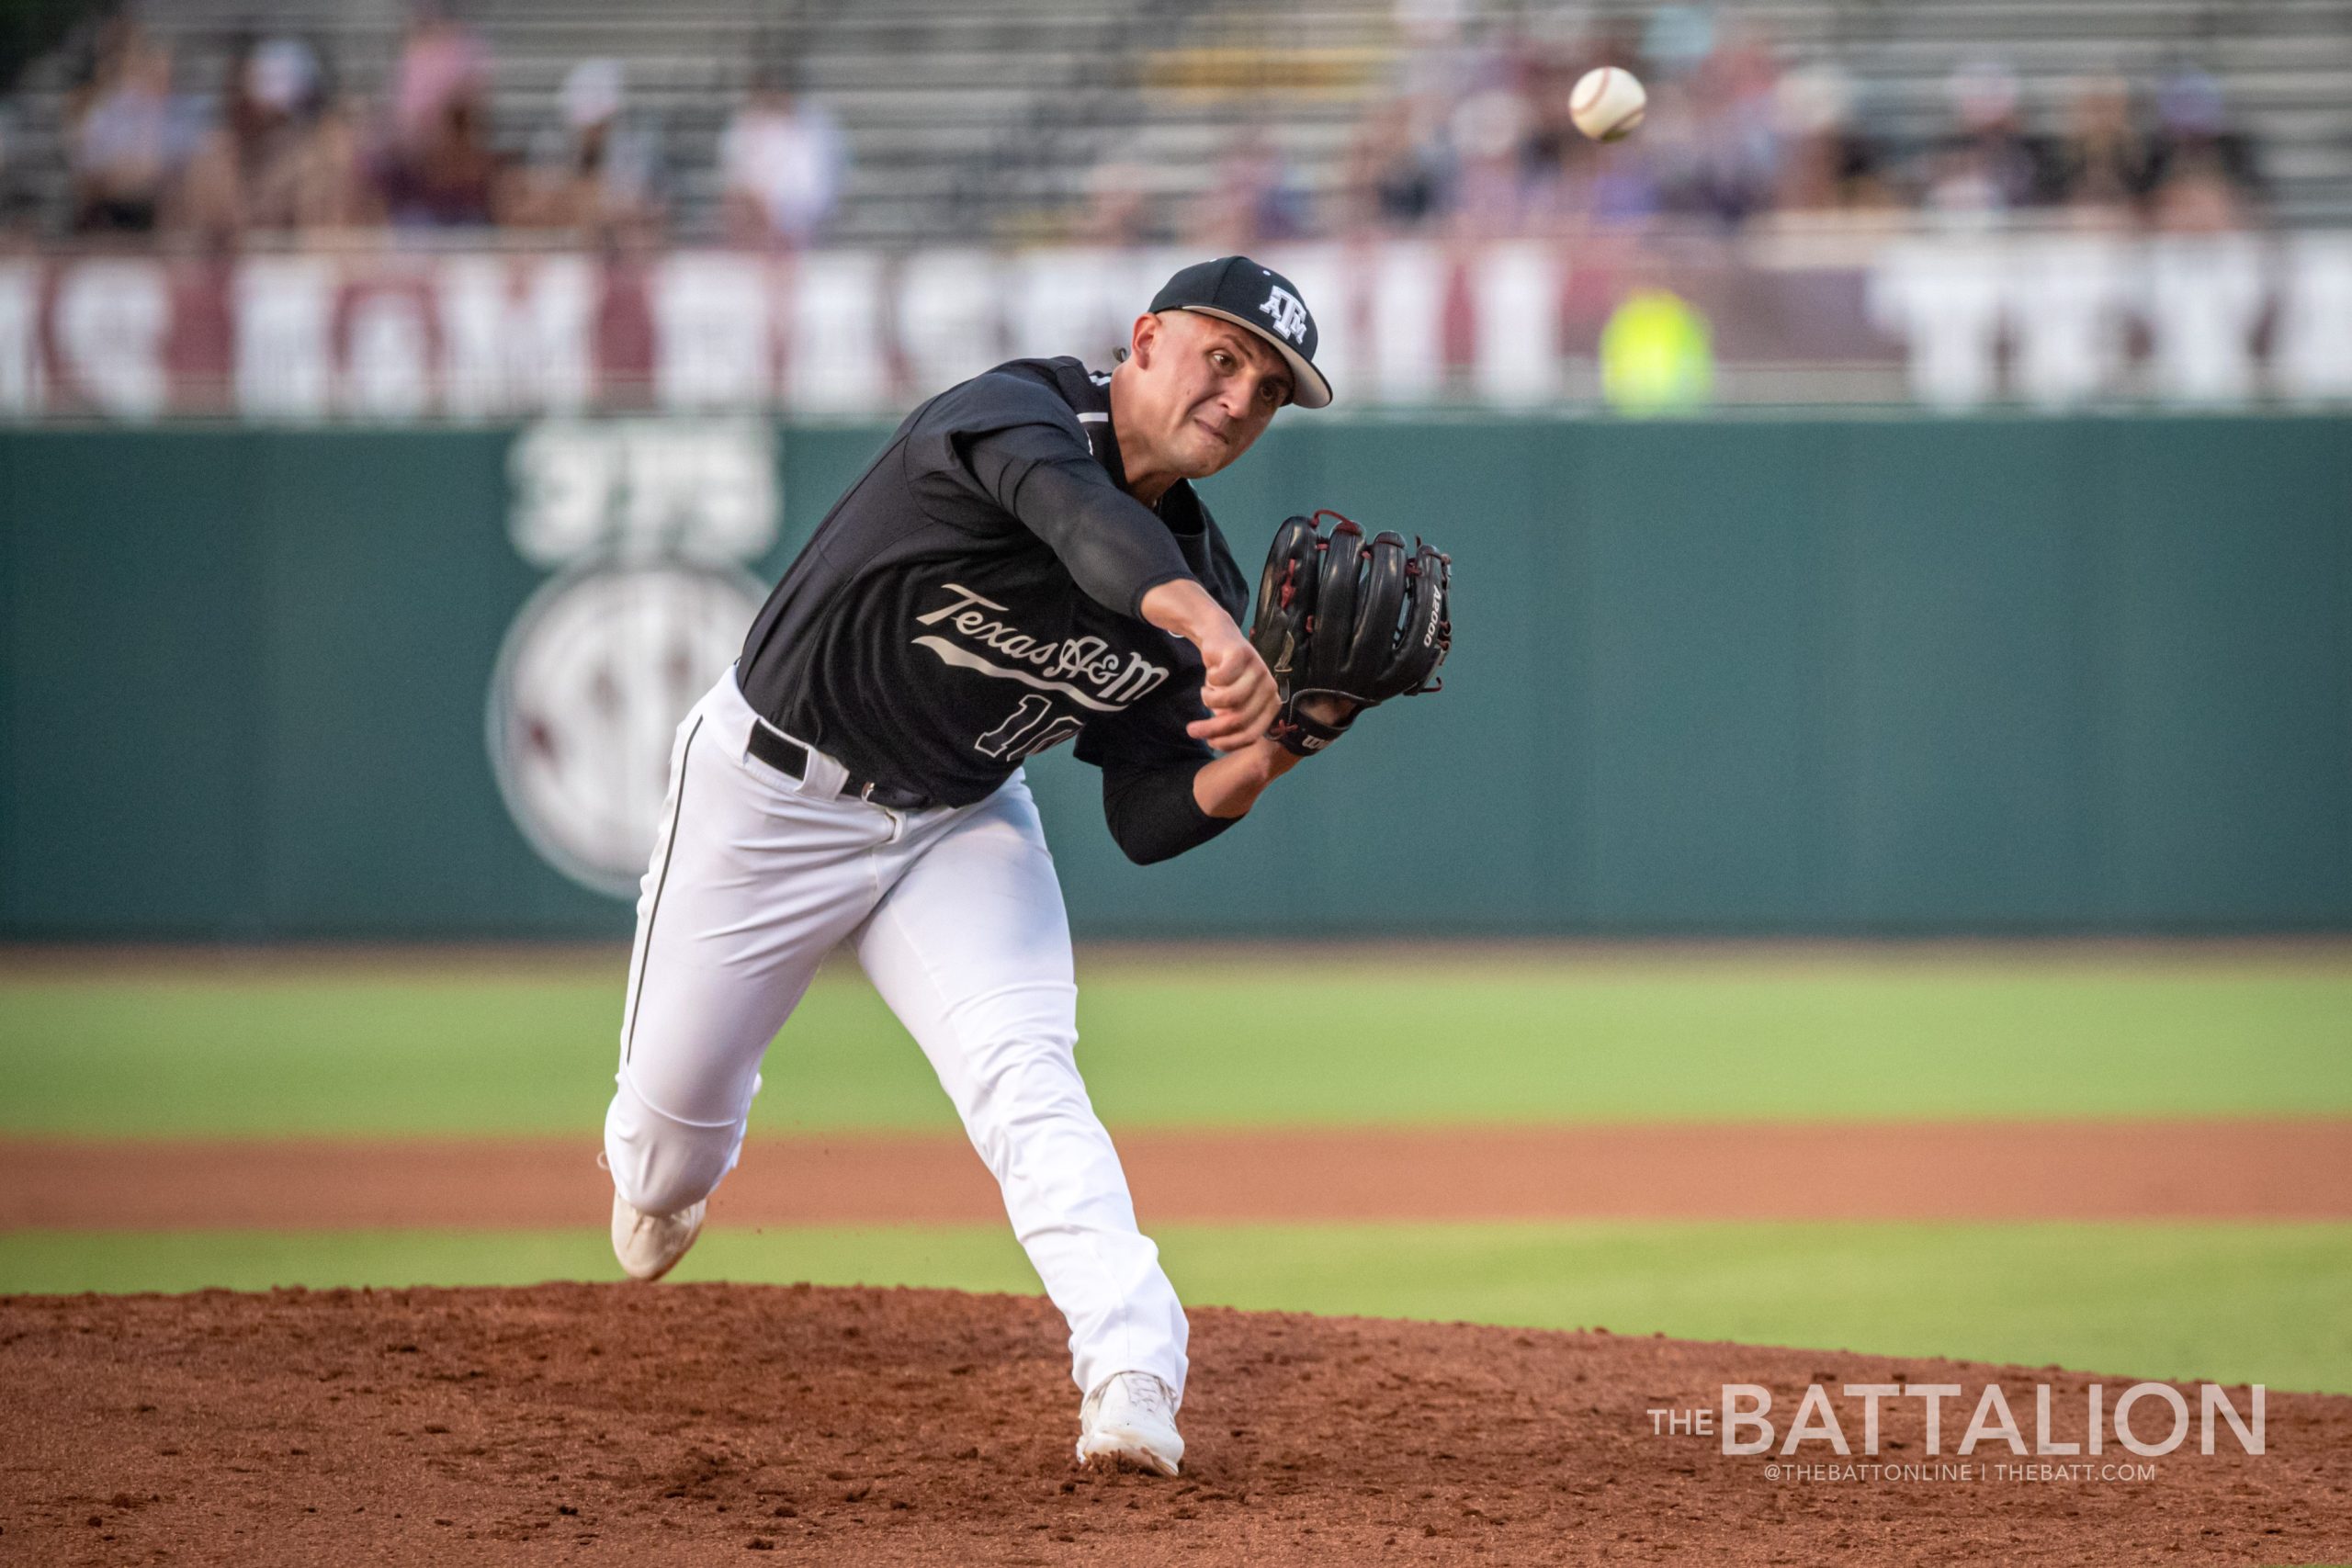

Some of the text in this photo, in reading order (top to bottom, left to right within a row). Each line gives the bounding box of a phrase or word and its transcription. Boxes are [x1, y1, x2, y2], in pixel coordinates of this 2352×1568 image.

[915, 583, 1170, 703] Texas A&M
[1423, 584, 1442, 648] A2000
